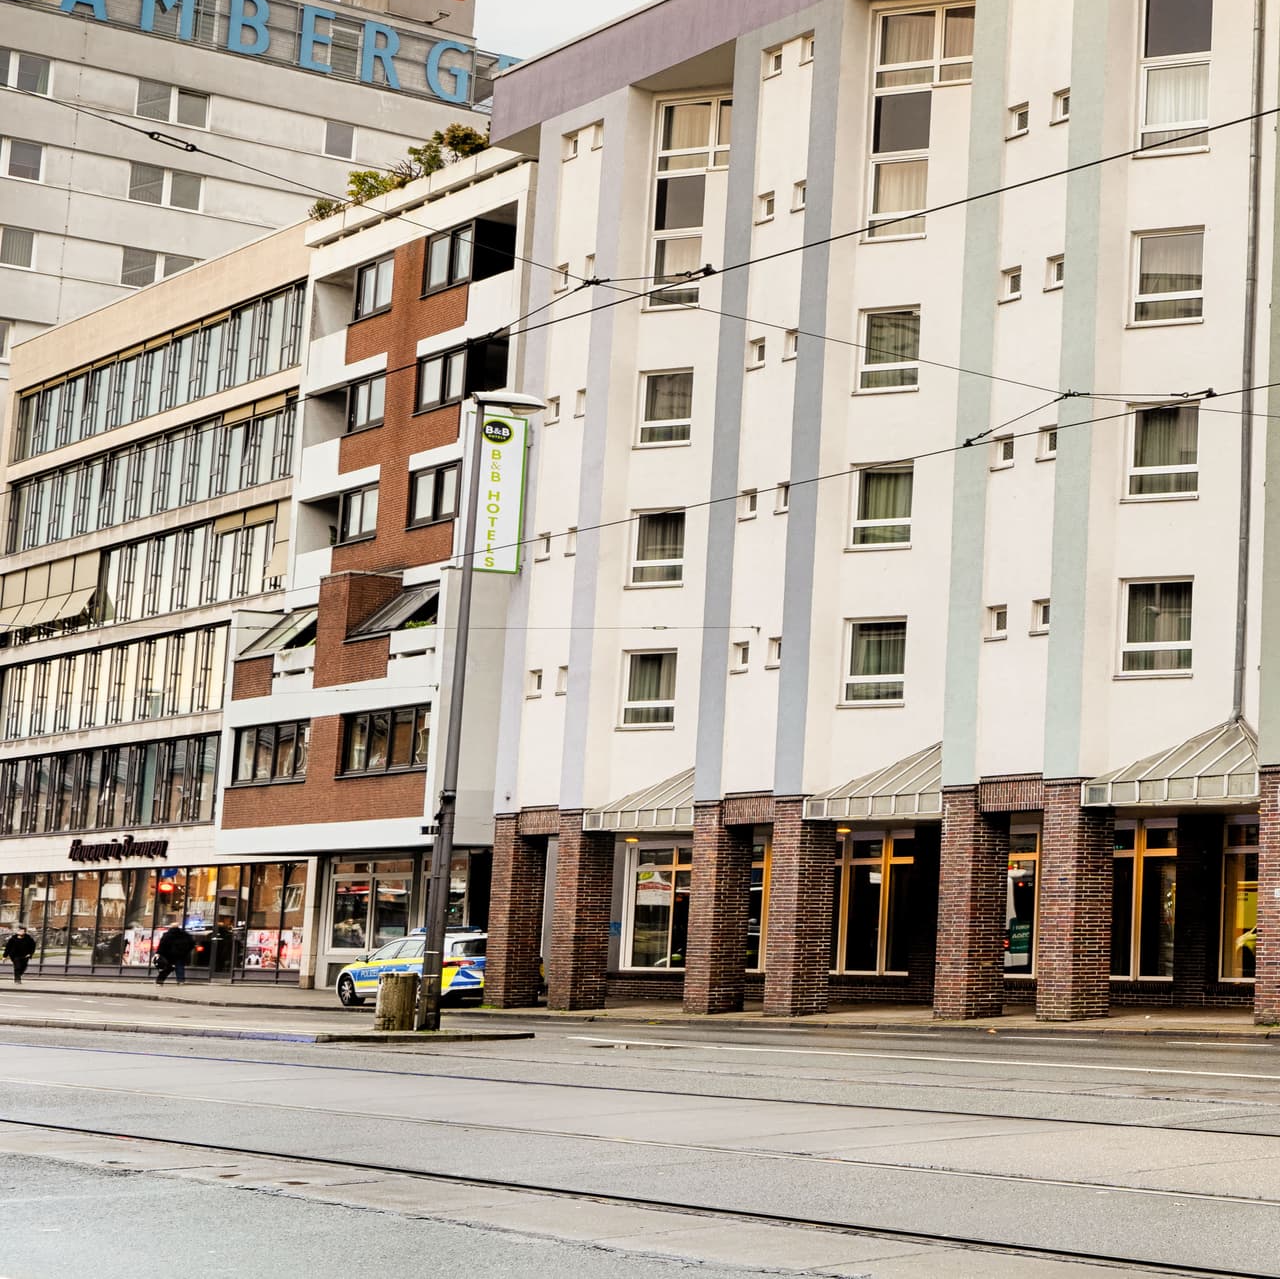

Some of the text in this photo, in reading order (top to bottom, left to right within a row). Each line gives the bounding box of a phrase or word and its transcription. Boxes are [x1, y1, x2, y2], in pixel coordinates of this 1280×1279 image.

[485, 425, 510, 437] B&B
[485, 449, 502, 568] B&B HOTELS
